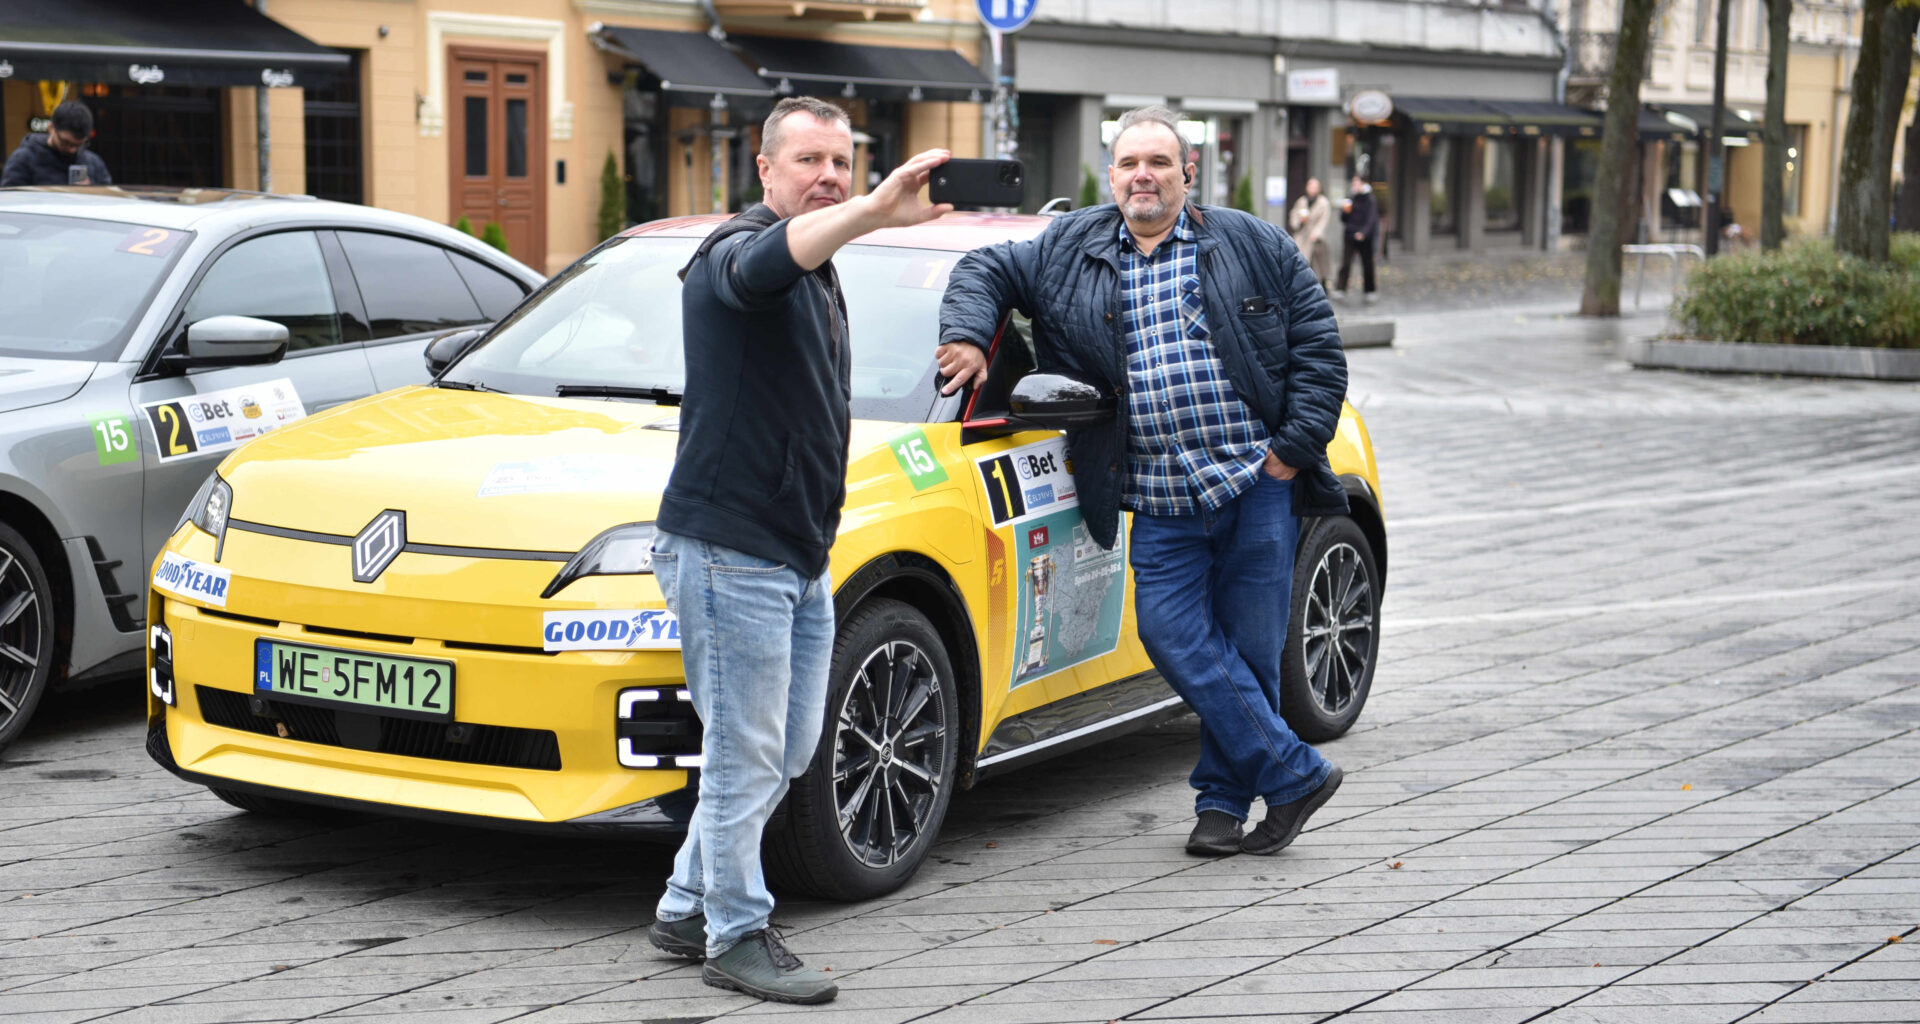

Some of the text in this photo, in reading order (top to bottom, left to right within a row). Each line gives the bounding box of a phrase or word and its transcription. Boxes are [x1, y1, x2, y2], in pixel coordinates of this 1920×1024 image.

[128, 229, 168, 255] 2
[923, 260, 946, 288] 1
[96, 419, 129, 452] 15
[158, 405, 188, 456] 2
[899, 438, 935, 476] 15
[992, 460, 1013, 518] 1
[259, 671, 271, 683] PL
[278, 649, 442, 710] WE 5FM12
